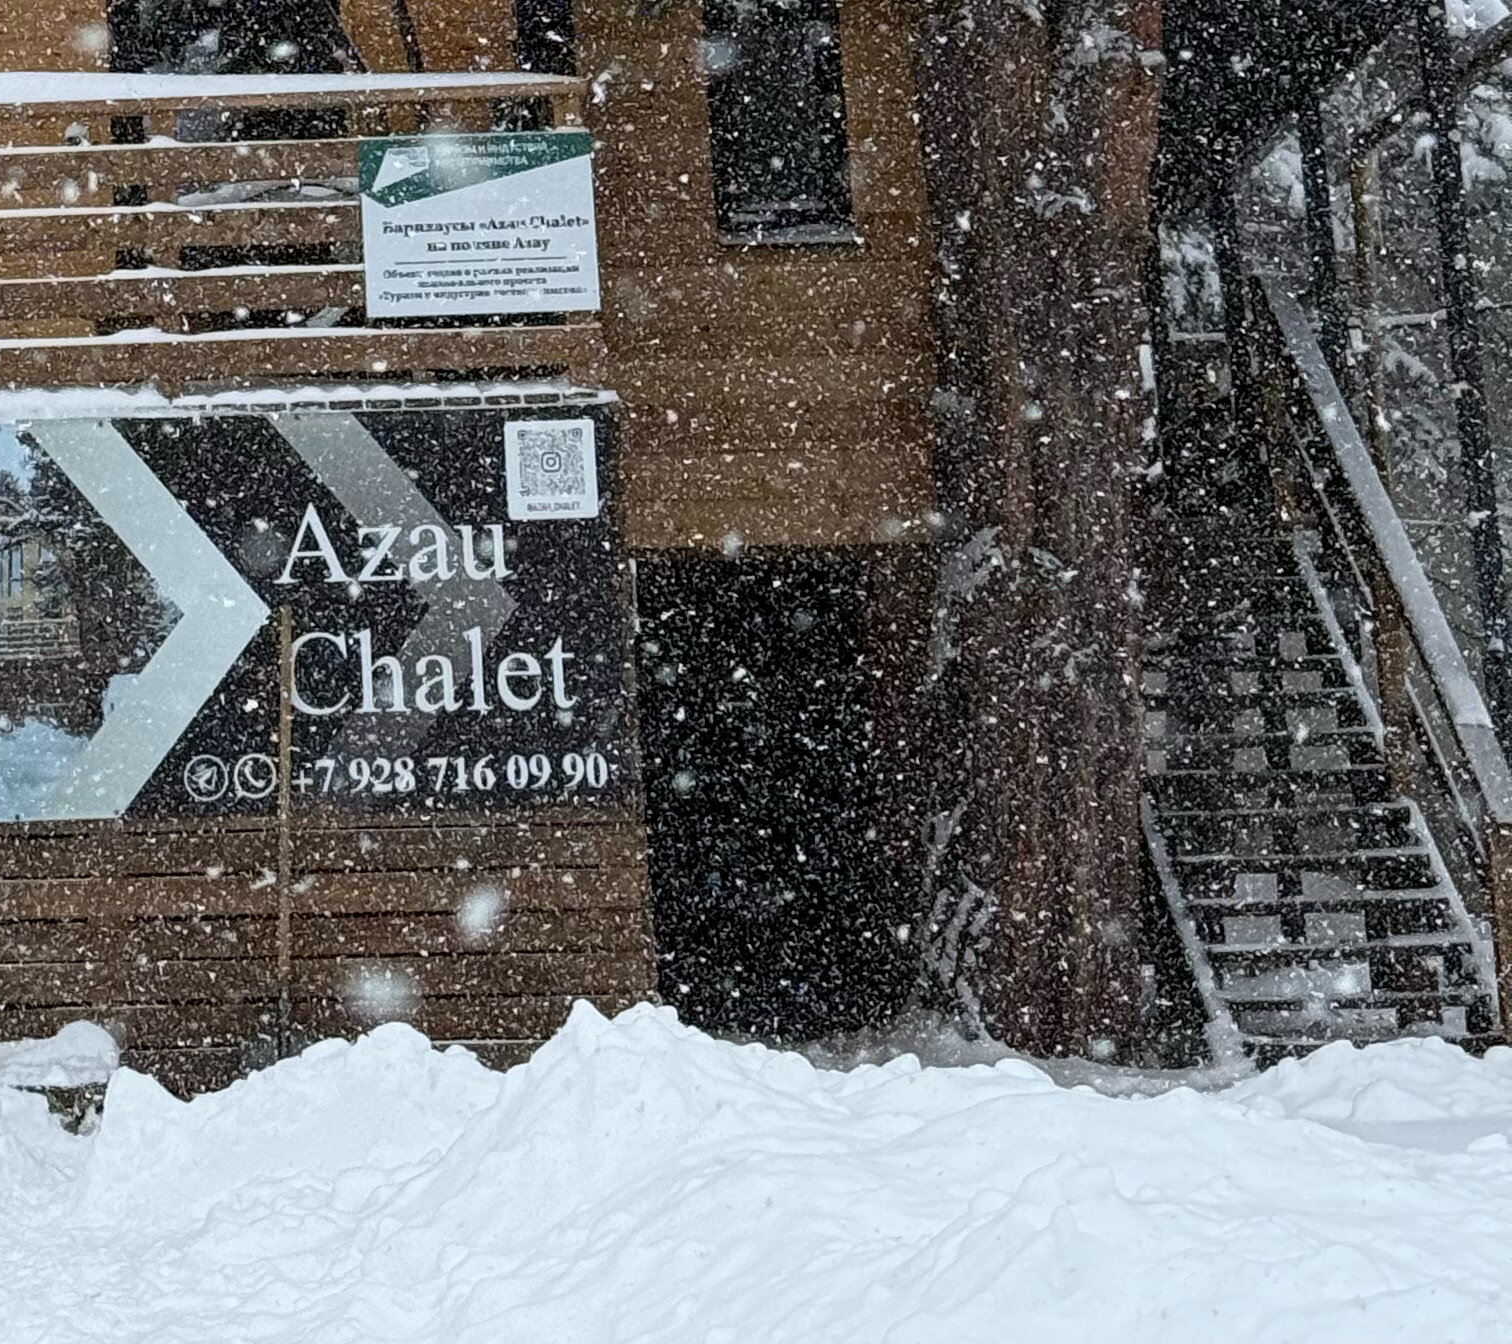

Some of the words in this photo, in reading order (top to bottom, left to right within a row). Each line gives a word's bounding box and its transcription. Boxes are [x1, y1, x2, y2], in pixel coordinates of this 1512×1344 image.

[273, 502, 514, 585] Azau
[289, 626, 578, 715] Chalet
[291, 758, 337, 793] +7
[349, 756, 416, 793] 928
[427, 755, 496, 792] 716
[506, 754, 551, 790] 09
[562, 752, 609, 789] 90
